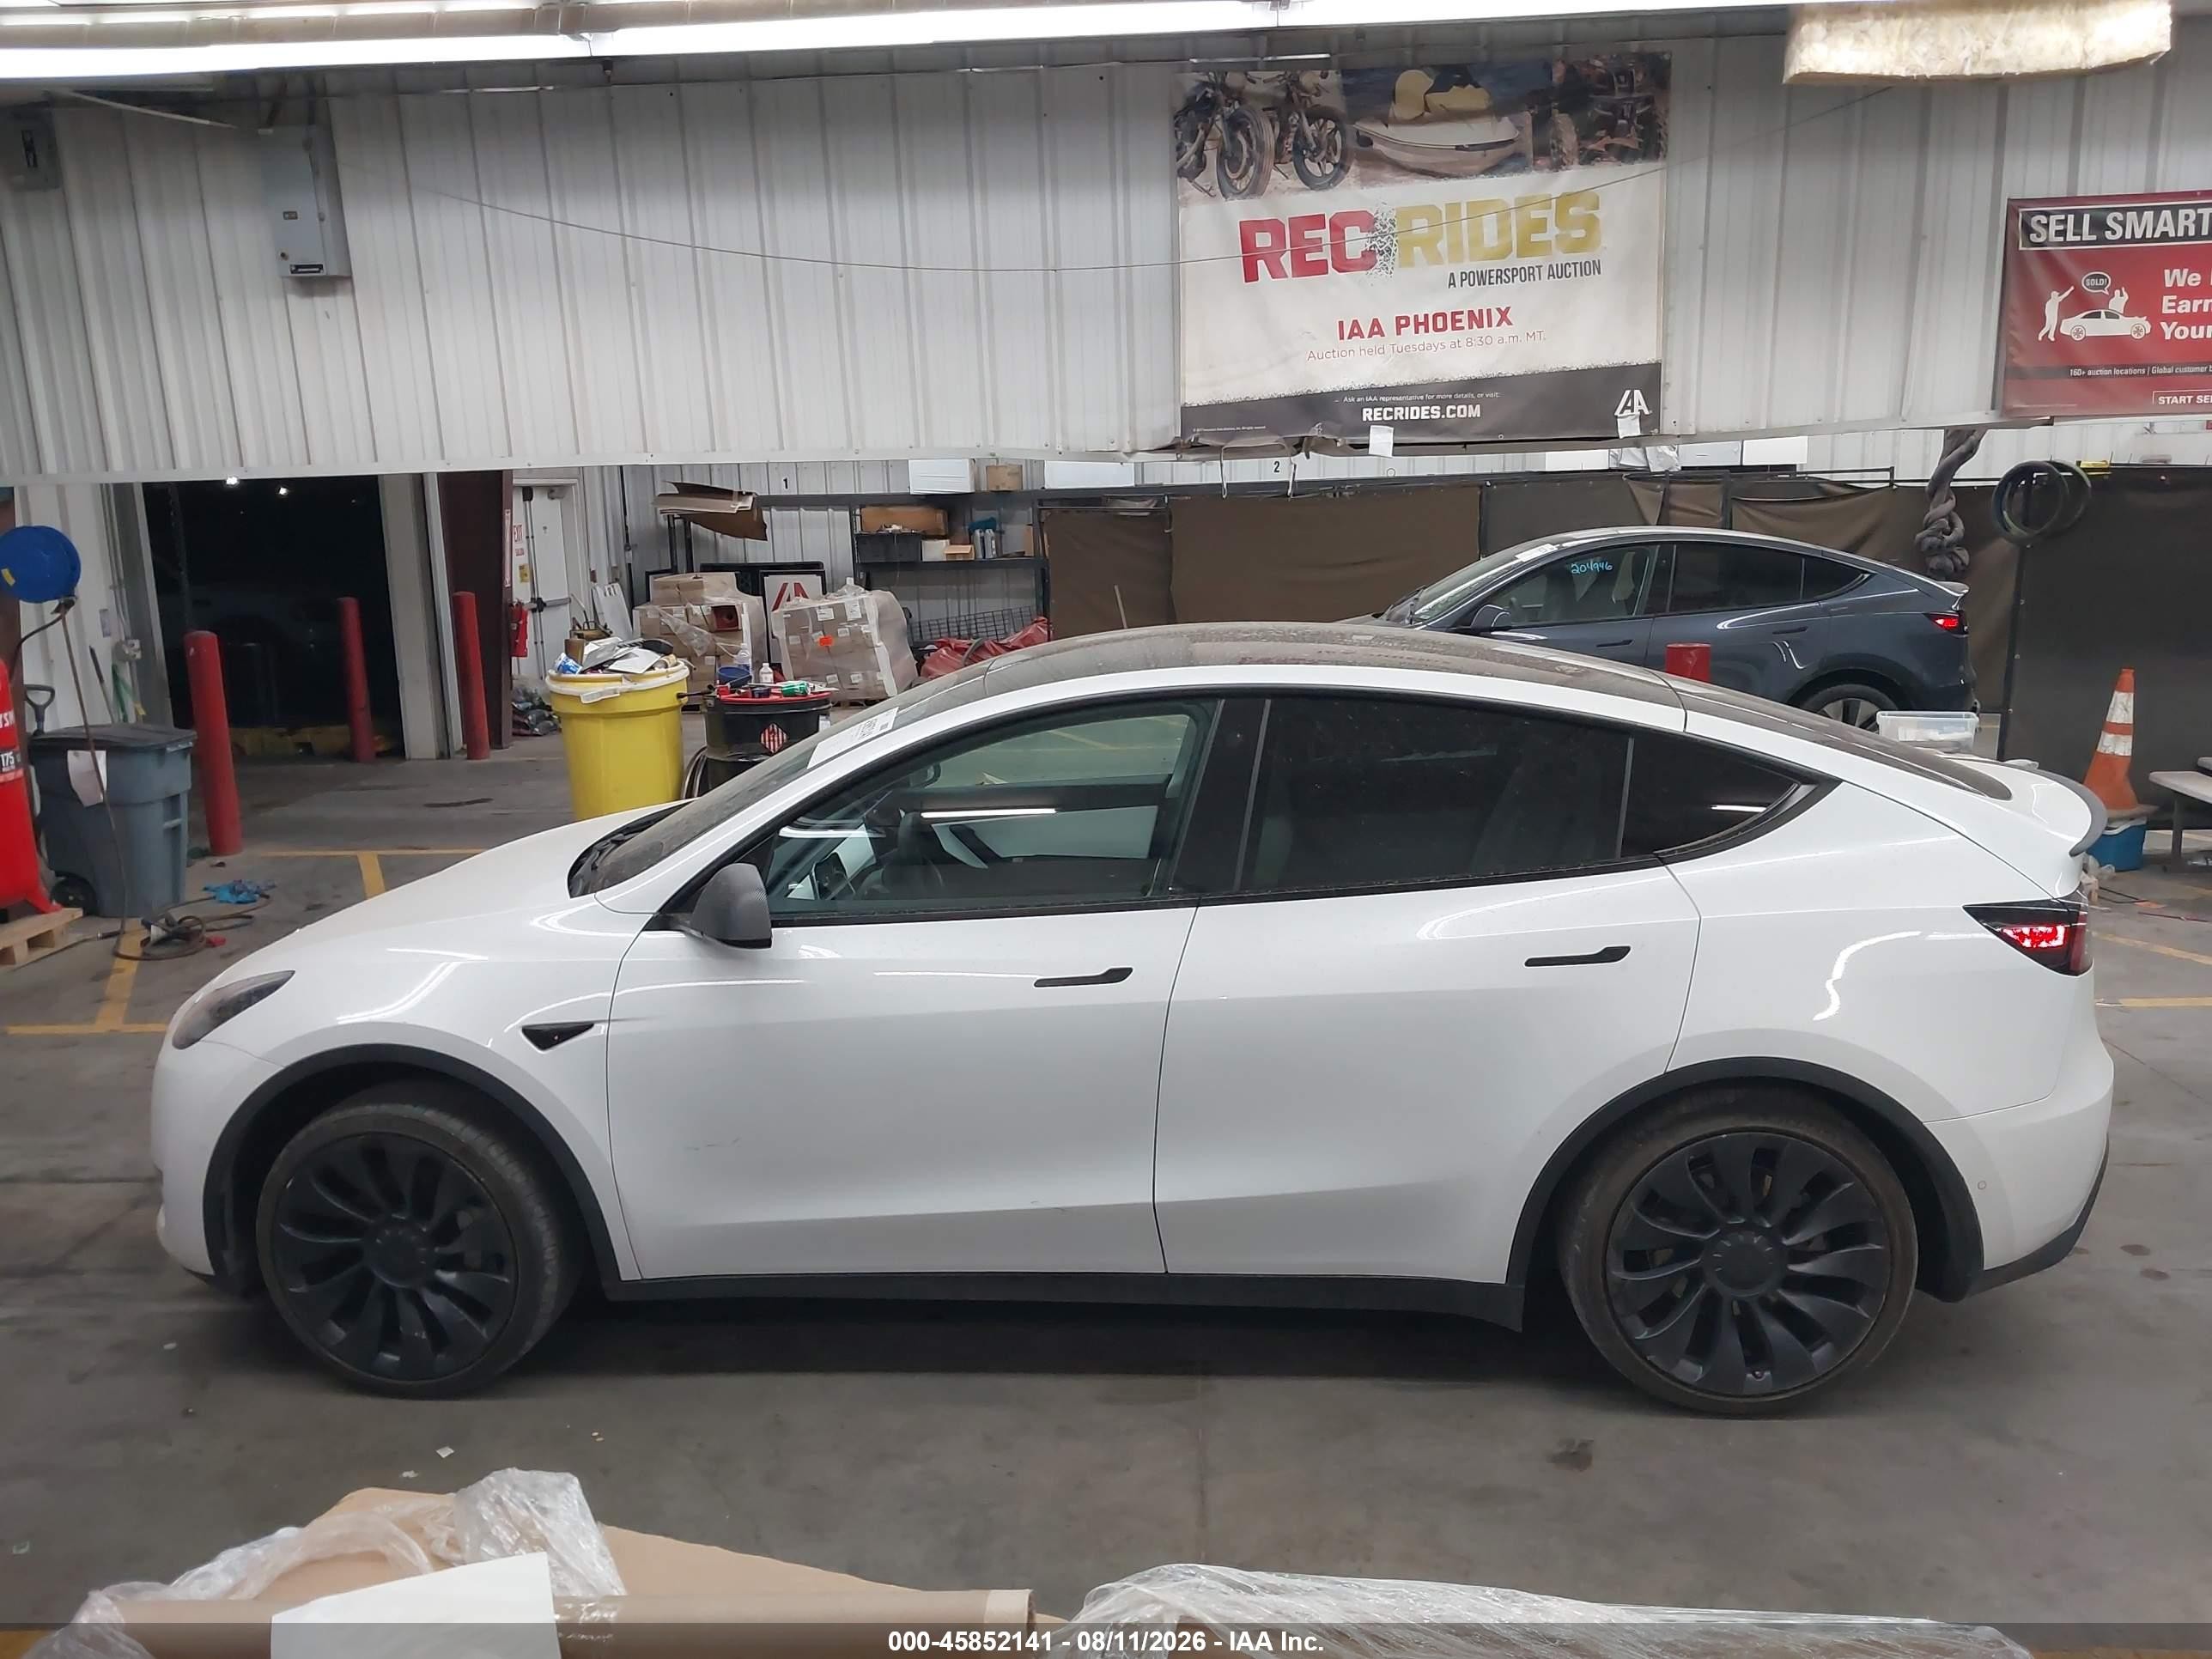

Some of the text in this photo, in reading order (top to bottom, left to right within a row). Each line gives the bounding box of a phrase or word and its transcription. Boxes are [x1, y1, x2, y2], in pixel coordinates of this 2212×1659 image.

[2029, 208, 2212, 243] SELL SMART
[1239, 191, 1602, 283] REC RIDES
[1448, 259, 1601, 289] A POWERSPORT AUCTION
[2086, 277, 2107, 287] SOLD!
[2164, 269, 2201, 288] We
[1338, 306, 1513, 341] IAA PHOENIX
[1307, 346, 1355, 362] Auction
[1359, 343, 1385, 356] held
[1389, 340, 1446, 356] Tuesdays
[1449, 337, 1462, 349] at
[1465, 336, 1493, 348] 8:30
[1497, 333, 1522, 346] a.m.
[2069, 368, 2086, 377] 160+
[2114, 367, 2145, 375] locations
[2151, 366, 2173, 374] Global
[1379, 393, 1424, 402] representative
[2158, 395, 2193, 405] START
[1362, 404, 1481, 422] RECRIDES.COM
[1273, 460, 1280, 473] 2
[783, 477, 788, 489] 1
[1571, 560, 1613, 574] 204946
[1, 751, 15, 767] 175
